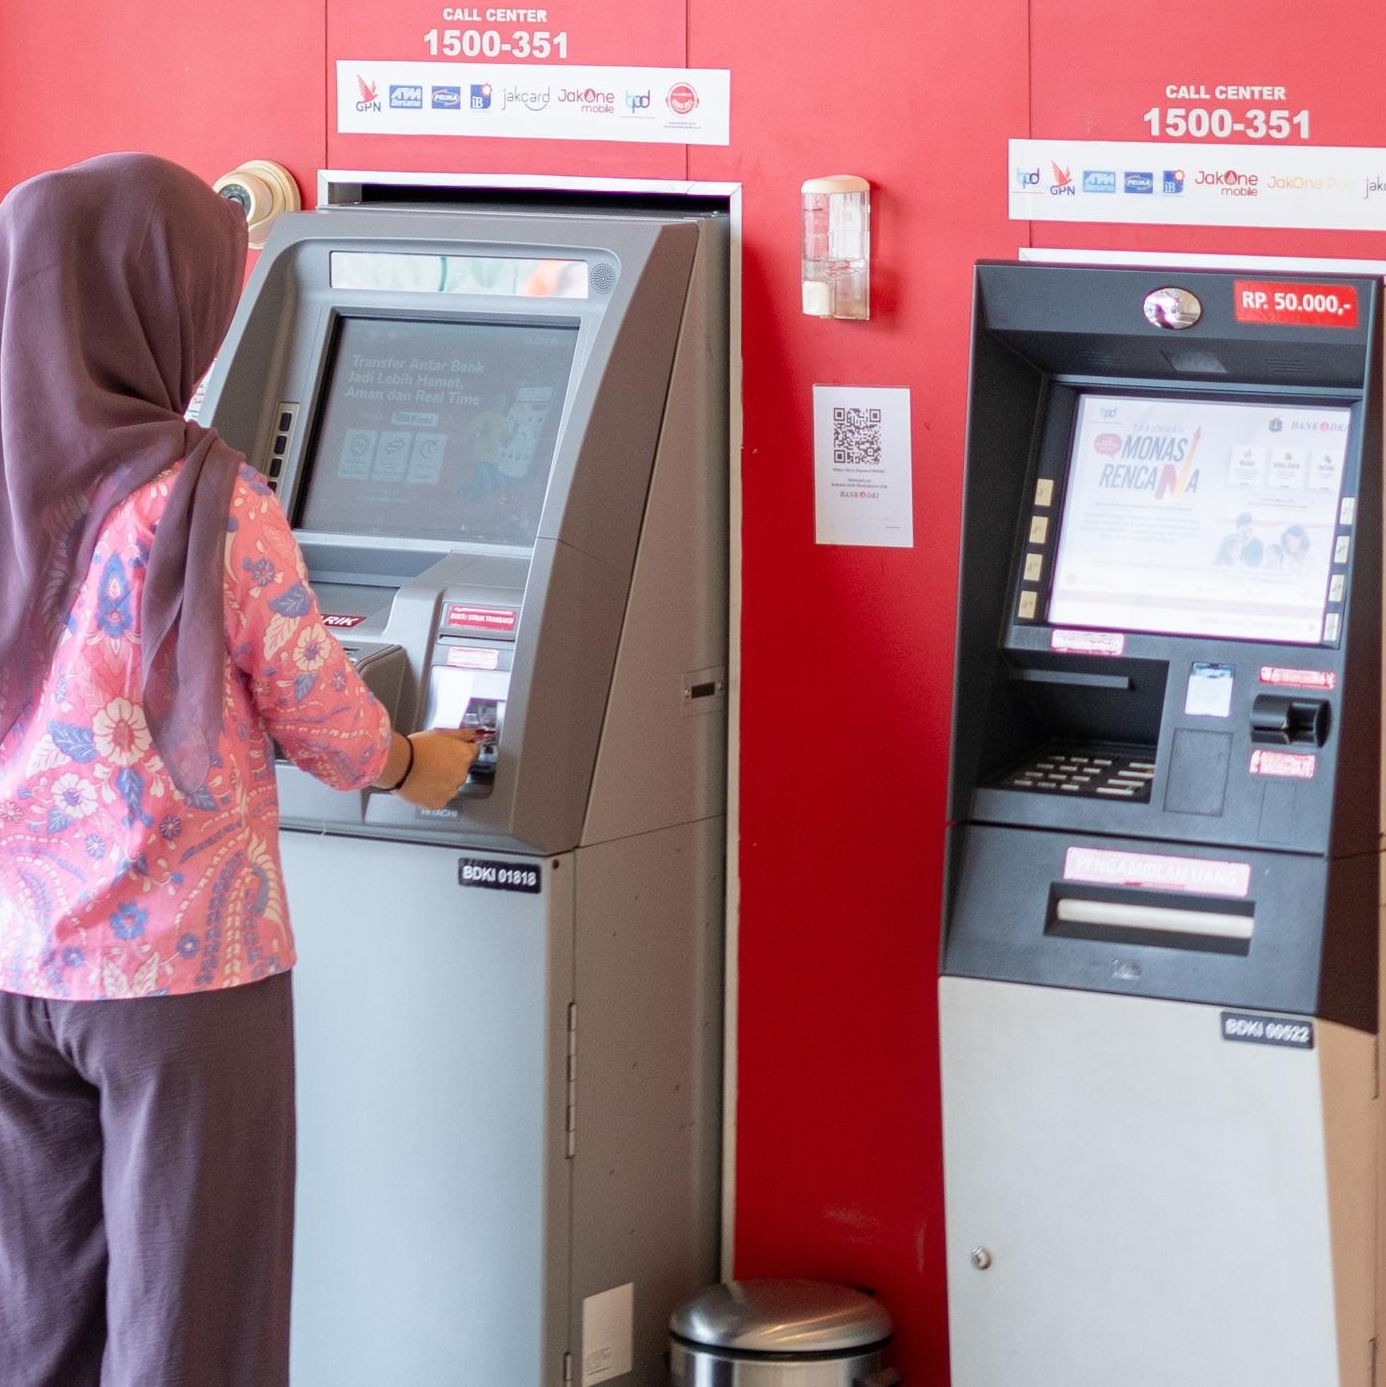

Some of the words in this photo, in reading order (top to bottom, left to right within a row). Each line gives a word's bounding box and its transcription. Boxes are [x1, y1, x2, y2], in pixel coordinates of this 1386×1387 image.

[442, 7, 481, 22] CALL
[485, 8, 548, 23] CENTER
[422, 28, 569, 59] 1500-351
[390, 87, 422, 100] ATM
[434, 93, 458, 102] PRIMA
[501, 86, 551, 111] jakcard
[557, 87, 615, 104] JakOne
[1165, 84, 1211, 100] CALL
[1214, 85, 1287, 101] CENTER
[355, 100, 382, 113] GPN
[472, 95, 483, 108] iB
[581, 102, 615, 114] mobile
[1142, 107, 1311, 140] 1500-351
[1084, 172, 1115, 185] ATM
[1126, 179, 1151, 187] PRIMA
[1194, 169, 1259, 187] JakOne
[1267, 175, 1322, 191] JakOne
[1049, 183, 1076, 197] GPN
[1220, 185, 1259, 198] mobile
[1241, 289, 1269, 310] RP.
[1273, 291, 1352, 318] 50.000,-
[352, 354, 406, 370] Transfer
[409, 357, 449, 372] Antar
[451, 359, 485, 374] Bank
[347, 370, 374, 383] Jadi
[378, 371, 413, 386] Lebih
[344, 385, 383, 401] Aman
[387, 388, 411, 402] dan
[416, 389, 444, 404] Real
[448, 391, 480, 406] Time
[1290, 420, 1319, 432] BANK
[1121, 434, 1188, 463] MONAS
[463, 864, 496, 882] BDKI
[497, 867, 537, 886] 01818
[1075, 855, 1187, 884] PENGAMBILAN
[1191, 865, 1239, 889] UANG
[1224, 1017, 1263, 1038] BDKI
[1264, 1021, 1310, 1045] 00522
